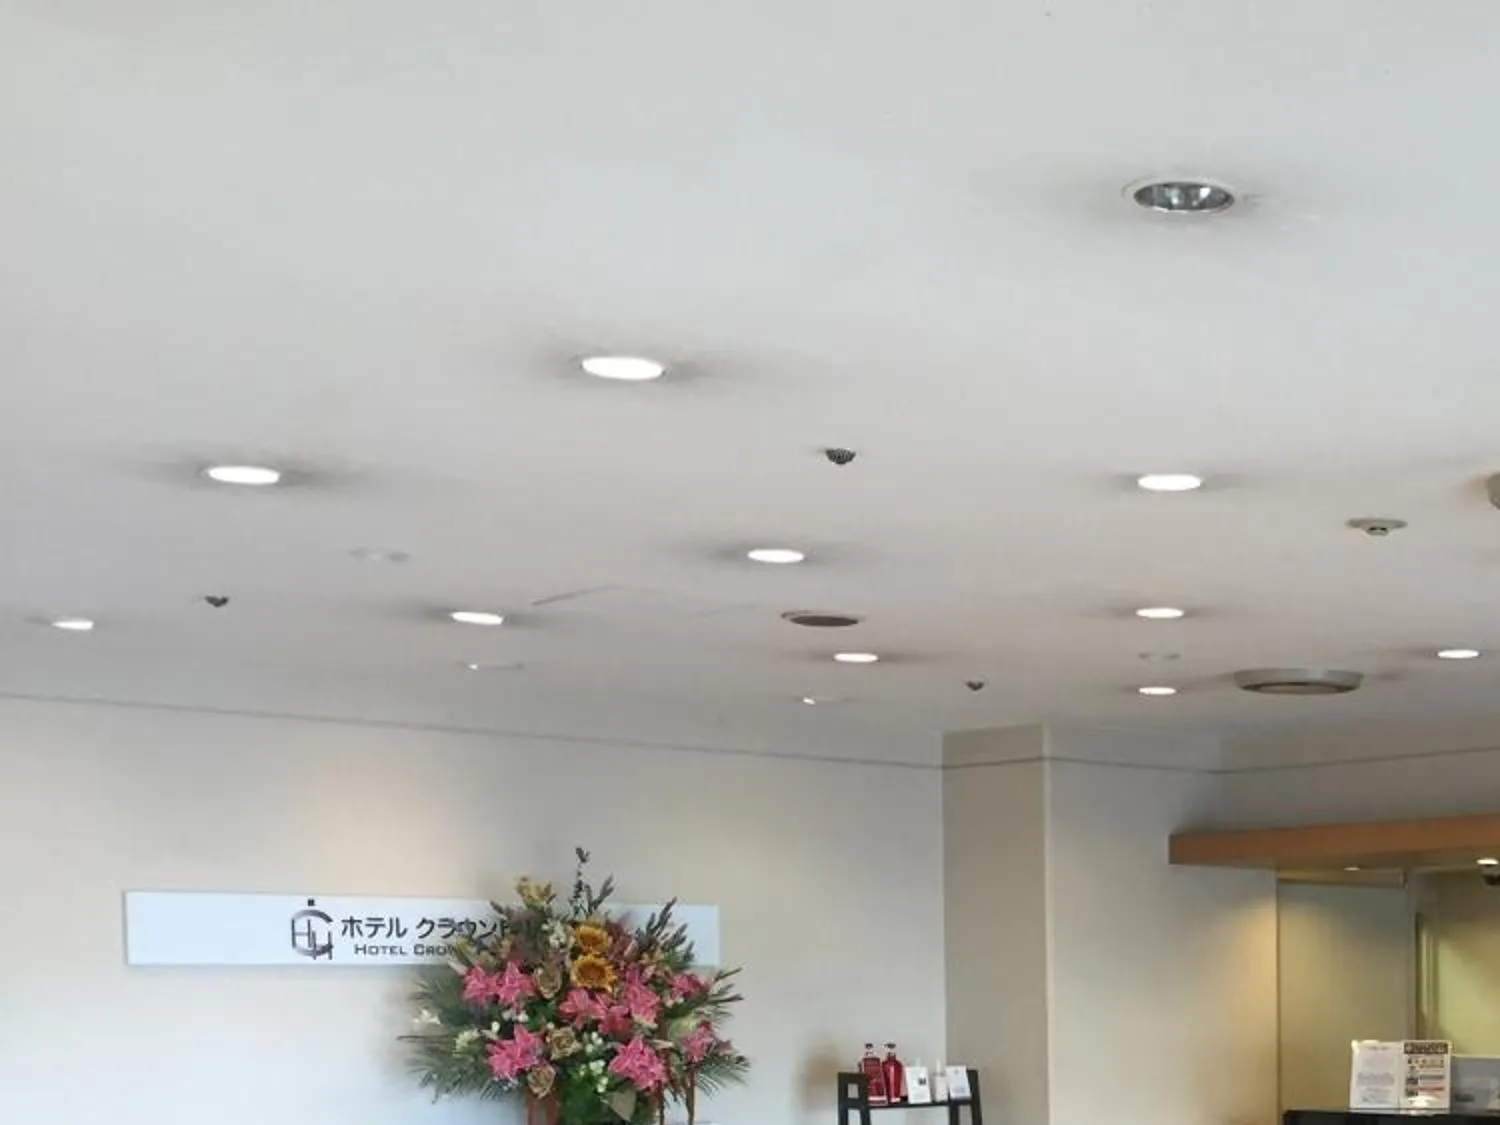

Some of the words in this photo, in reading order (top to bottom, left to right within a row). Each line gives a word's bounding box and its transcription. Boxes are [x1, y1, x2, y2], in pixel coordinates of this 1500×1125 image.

[341, 916, 408, 938] ホテル
[354, 943, 408, 956] HOTEL
